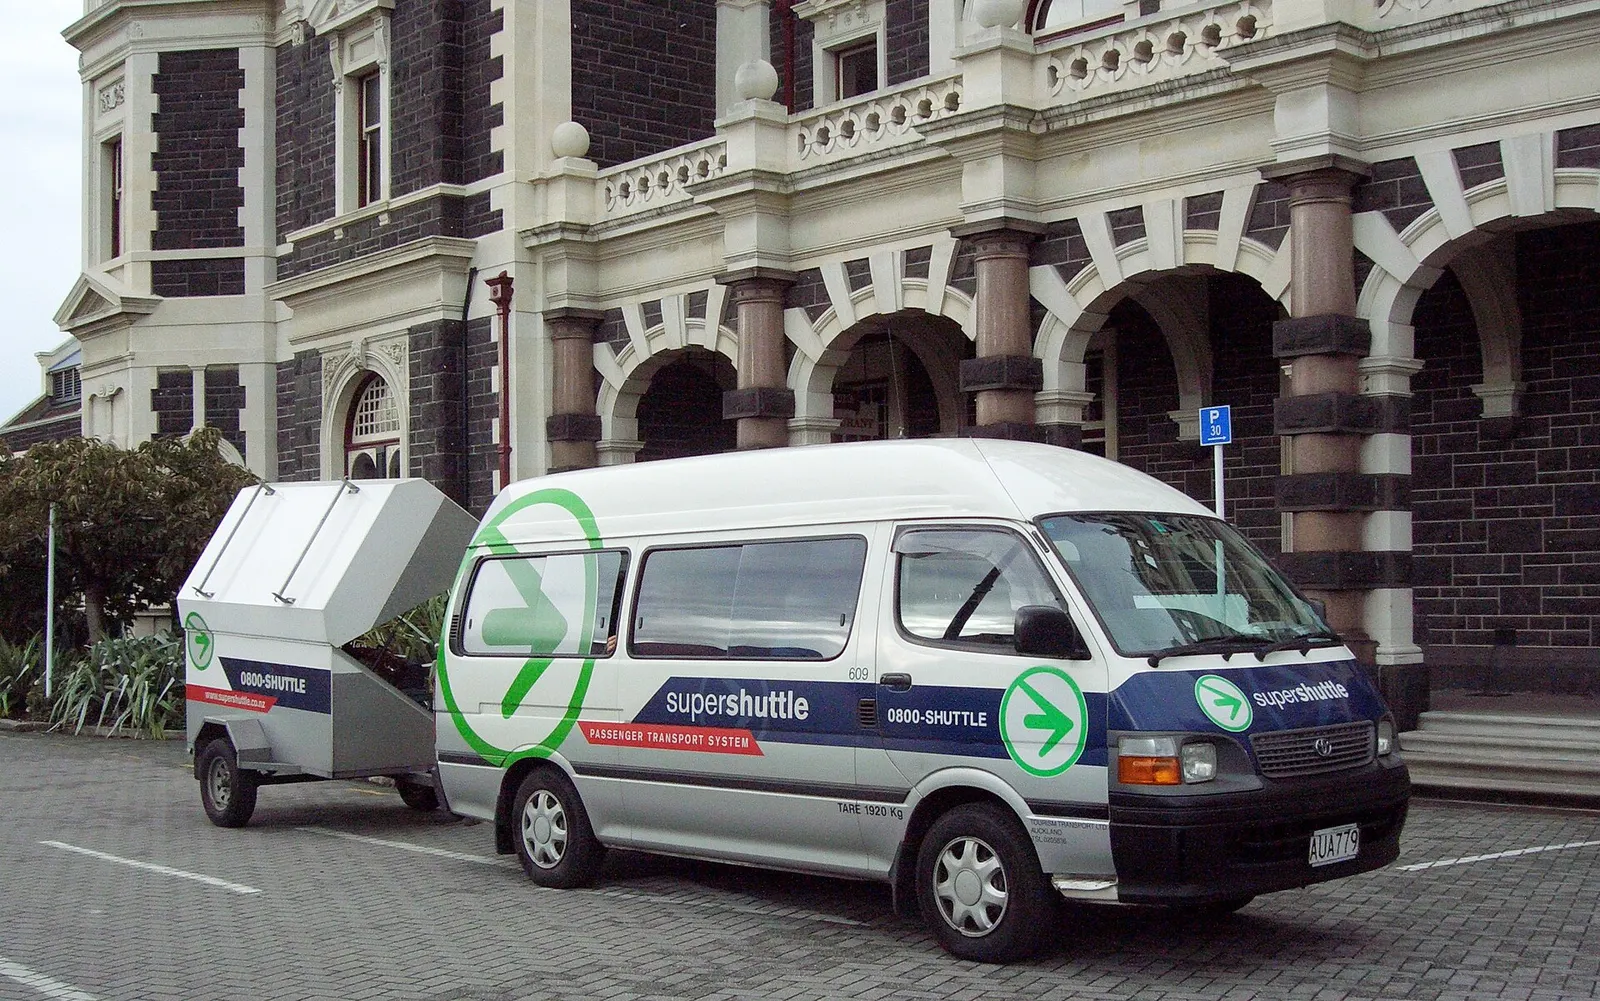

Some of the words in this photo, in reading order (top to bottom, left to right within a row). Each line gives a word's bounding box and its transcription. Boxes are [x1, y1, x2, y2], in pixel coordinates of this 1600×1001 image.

[1210, 410, 1220, 424] P
[1210, 425, 1221, 436] 30
[240, 671, 306, 694] 0800-SHUTTLE
[849, 667, 869, 681] 609
[1253, 680, 1349, 710] supershuttle
[666, 688, 809, 722] supershuttle
[887, 708, 987, 727] 0800-SHUTTLE
[589, 728, 643, 742] PASSENGER
[647, 732, 704, 746] TRANSPORT
[708, 735, 749, 748] SYSTEM
[837, 803, 861, 814] TARE
[864, 805, 887, 817] 1920
[890, 807, 903, 820] Kg
[1310, 830, 1358, 861] AUA779
